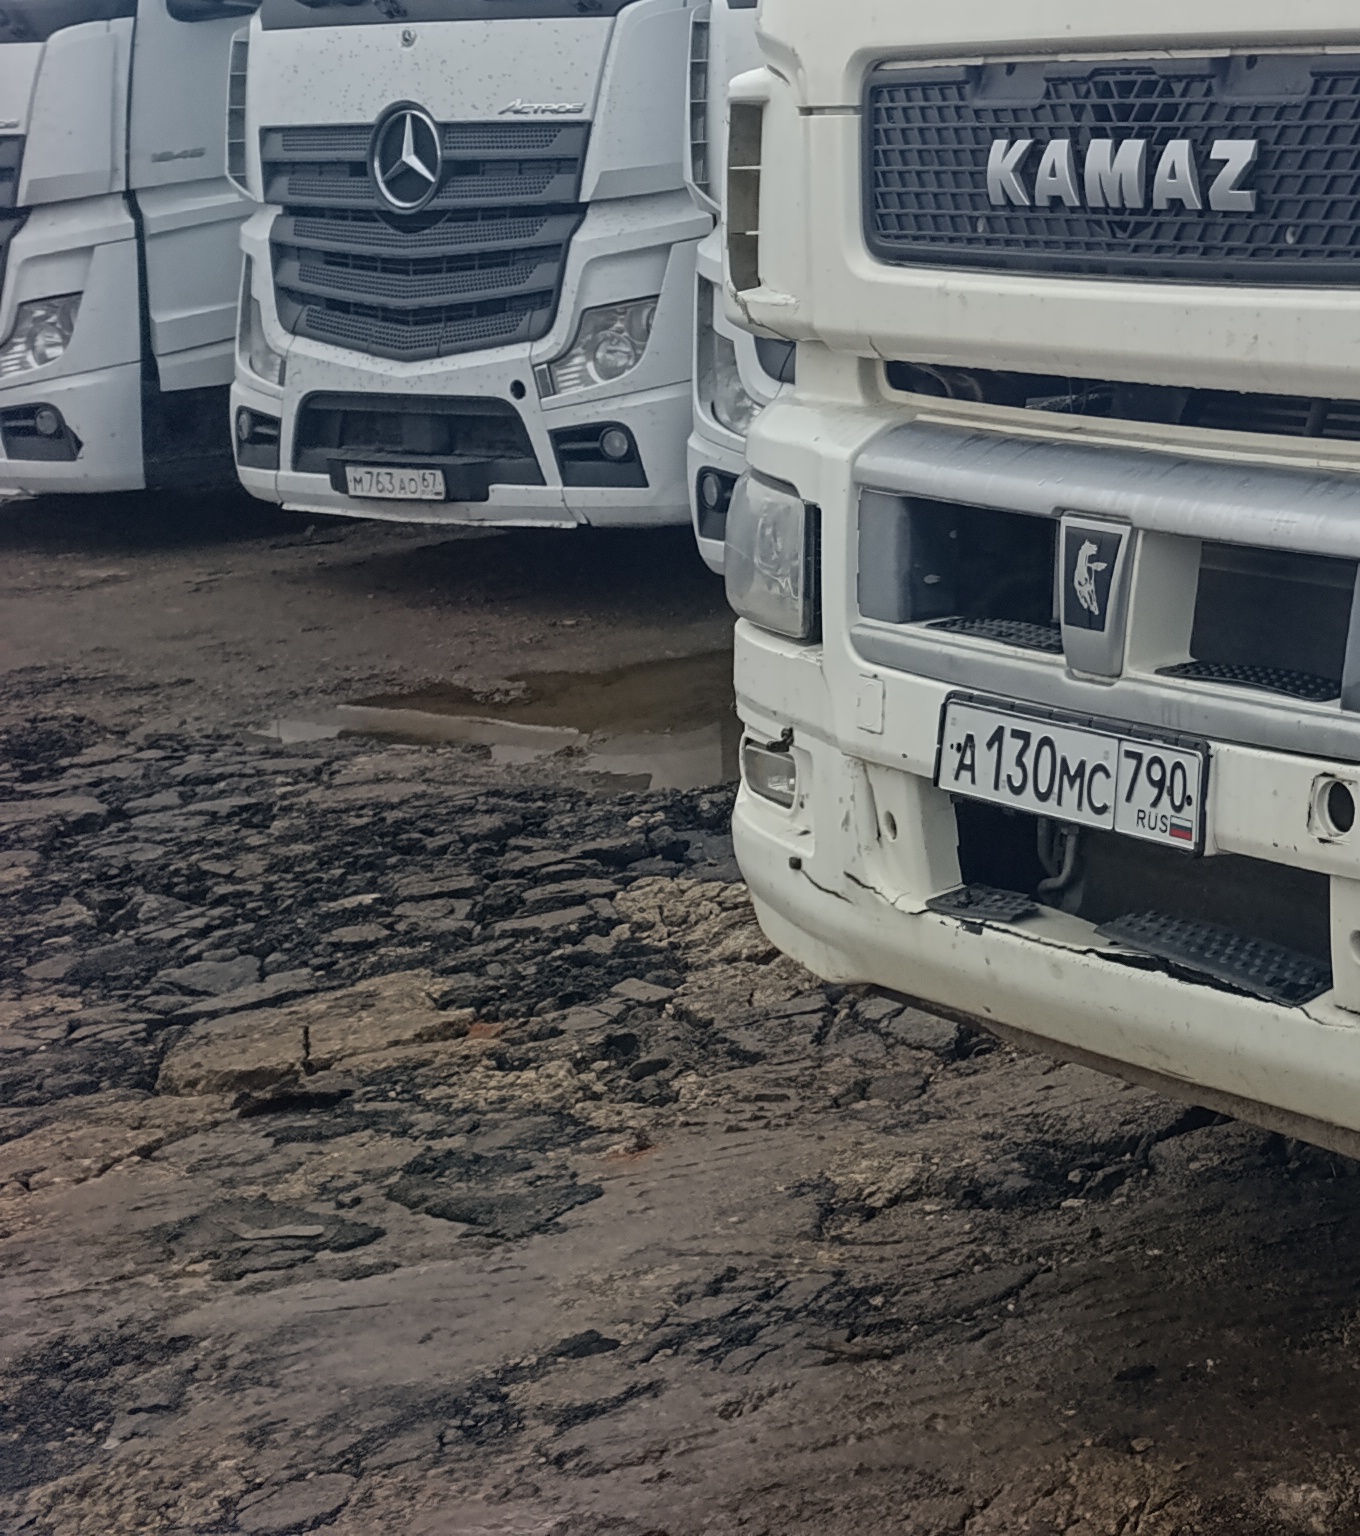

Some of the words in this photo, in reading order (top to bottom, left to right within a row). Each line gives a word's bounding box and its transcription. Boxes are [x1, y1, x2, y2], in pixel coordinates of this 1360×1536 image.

[987, 138, 1259, 212] KAMAZ
[1123, 749, 1188, 813] 790
[1136, 809, 1168, 833] RUS
